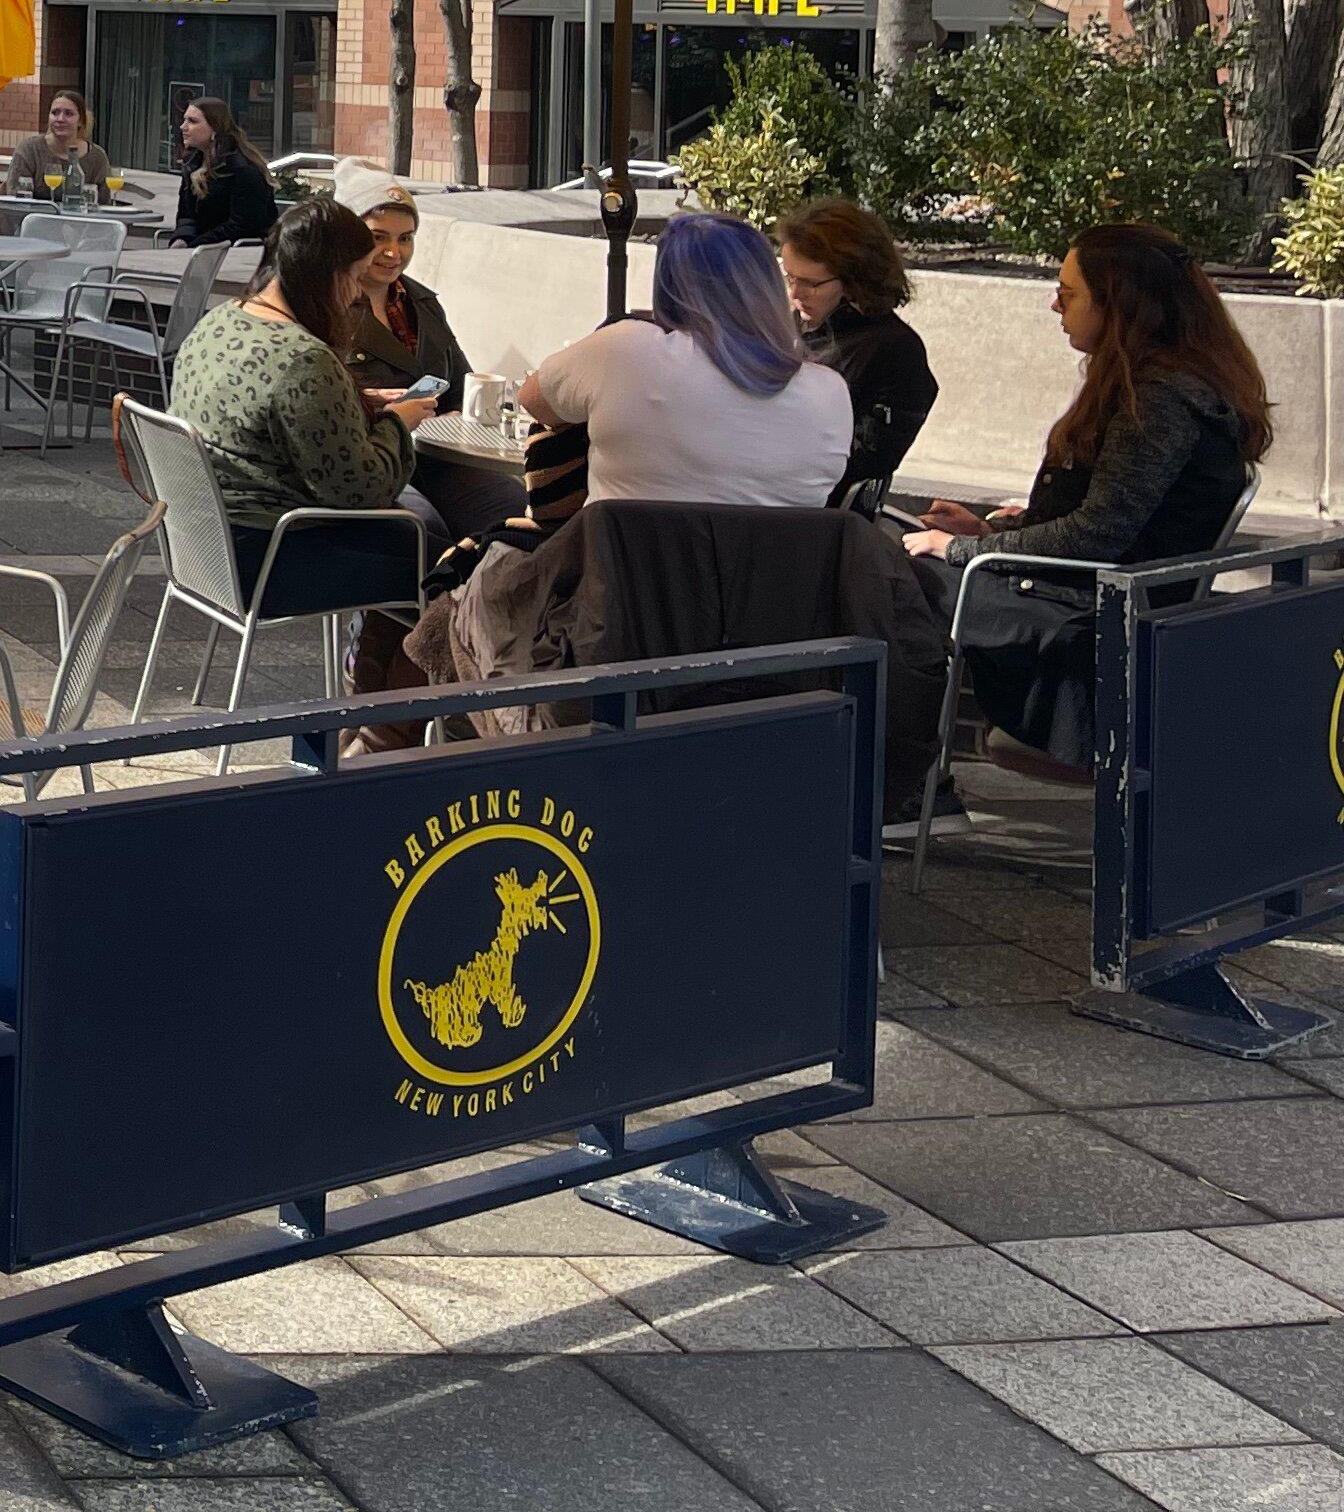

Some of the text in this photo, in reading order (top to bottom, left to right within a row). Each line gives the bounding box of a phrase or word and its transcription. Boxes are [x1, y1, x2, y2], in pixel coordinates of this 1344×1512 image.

[384, 789, 594, 888] BARKING DOG
[394, 1037, 575, 1118] NEW YORK CITY
